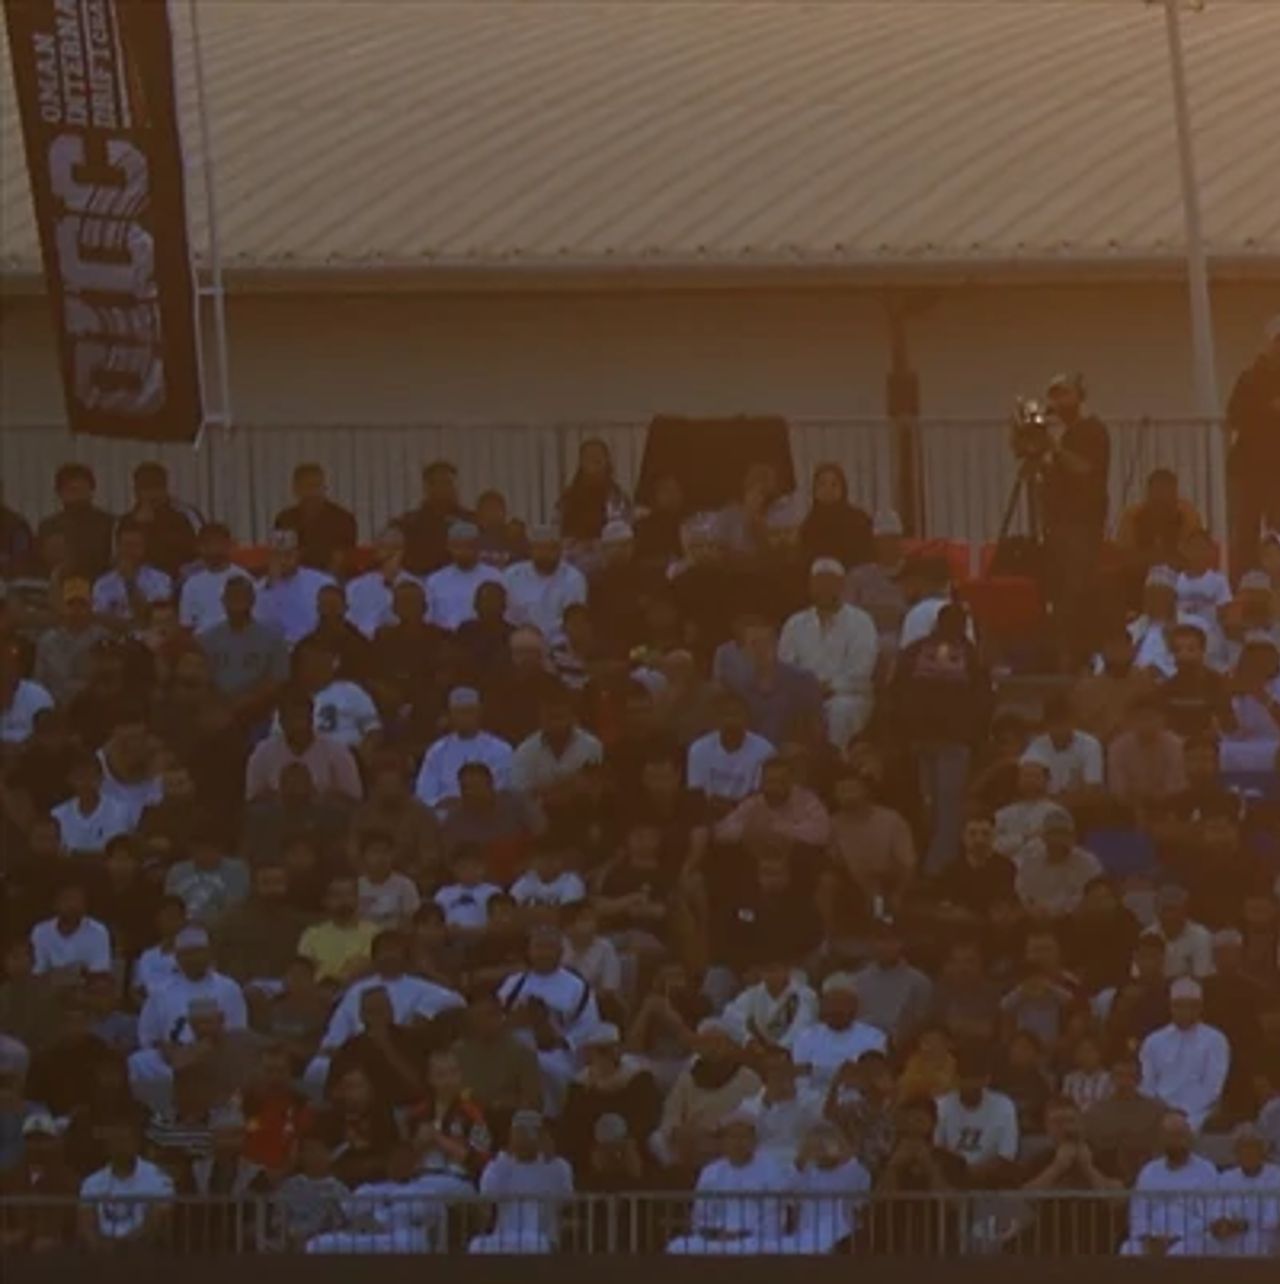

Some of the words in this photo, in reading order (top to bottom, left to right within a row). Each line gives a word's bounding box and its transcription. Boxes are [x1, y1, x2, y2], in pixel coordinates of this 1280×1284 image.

[33, 34, 62, 122] OMAN
[87, 47, 117, 129] DRIFT
[49, 134, 164, 412] OIDC
